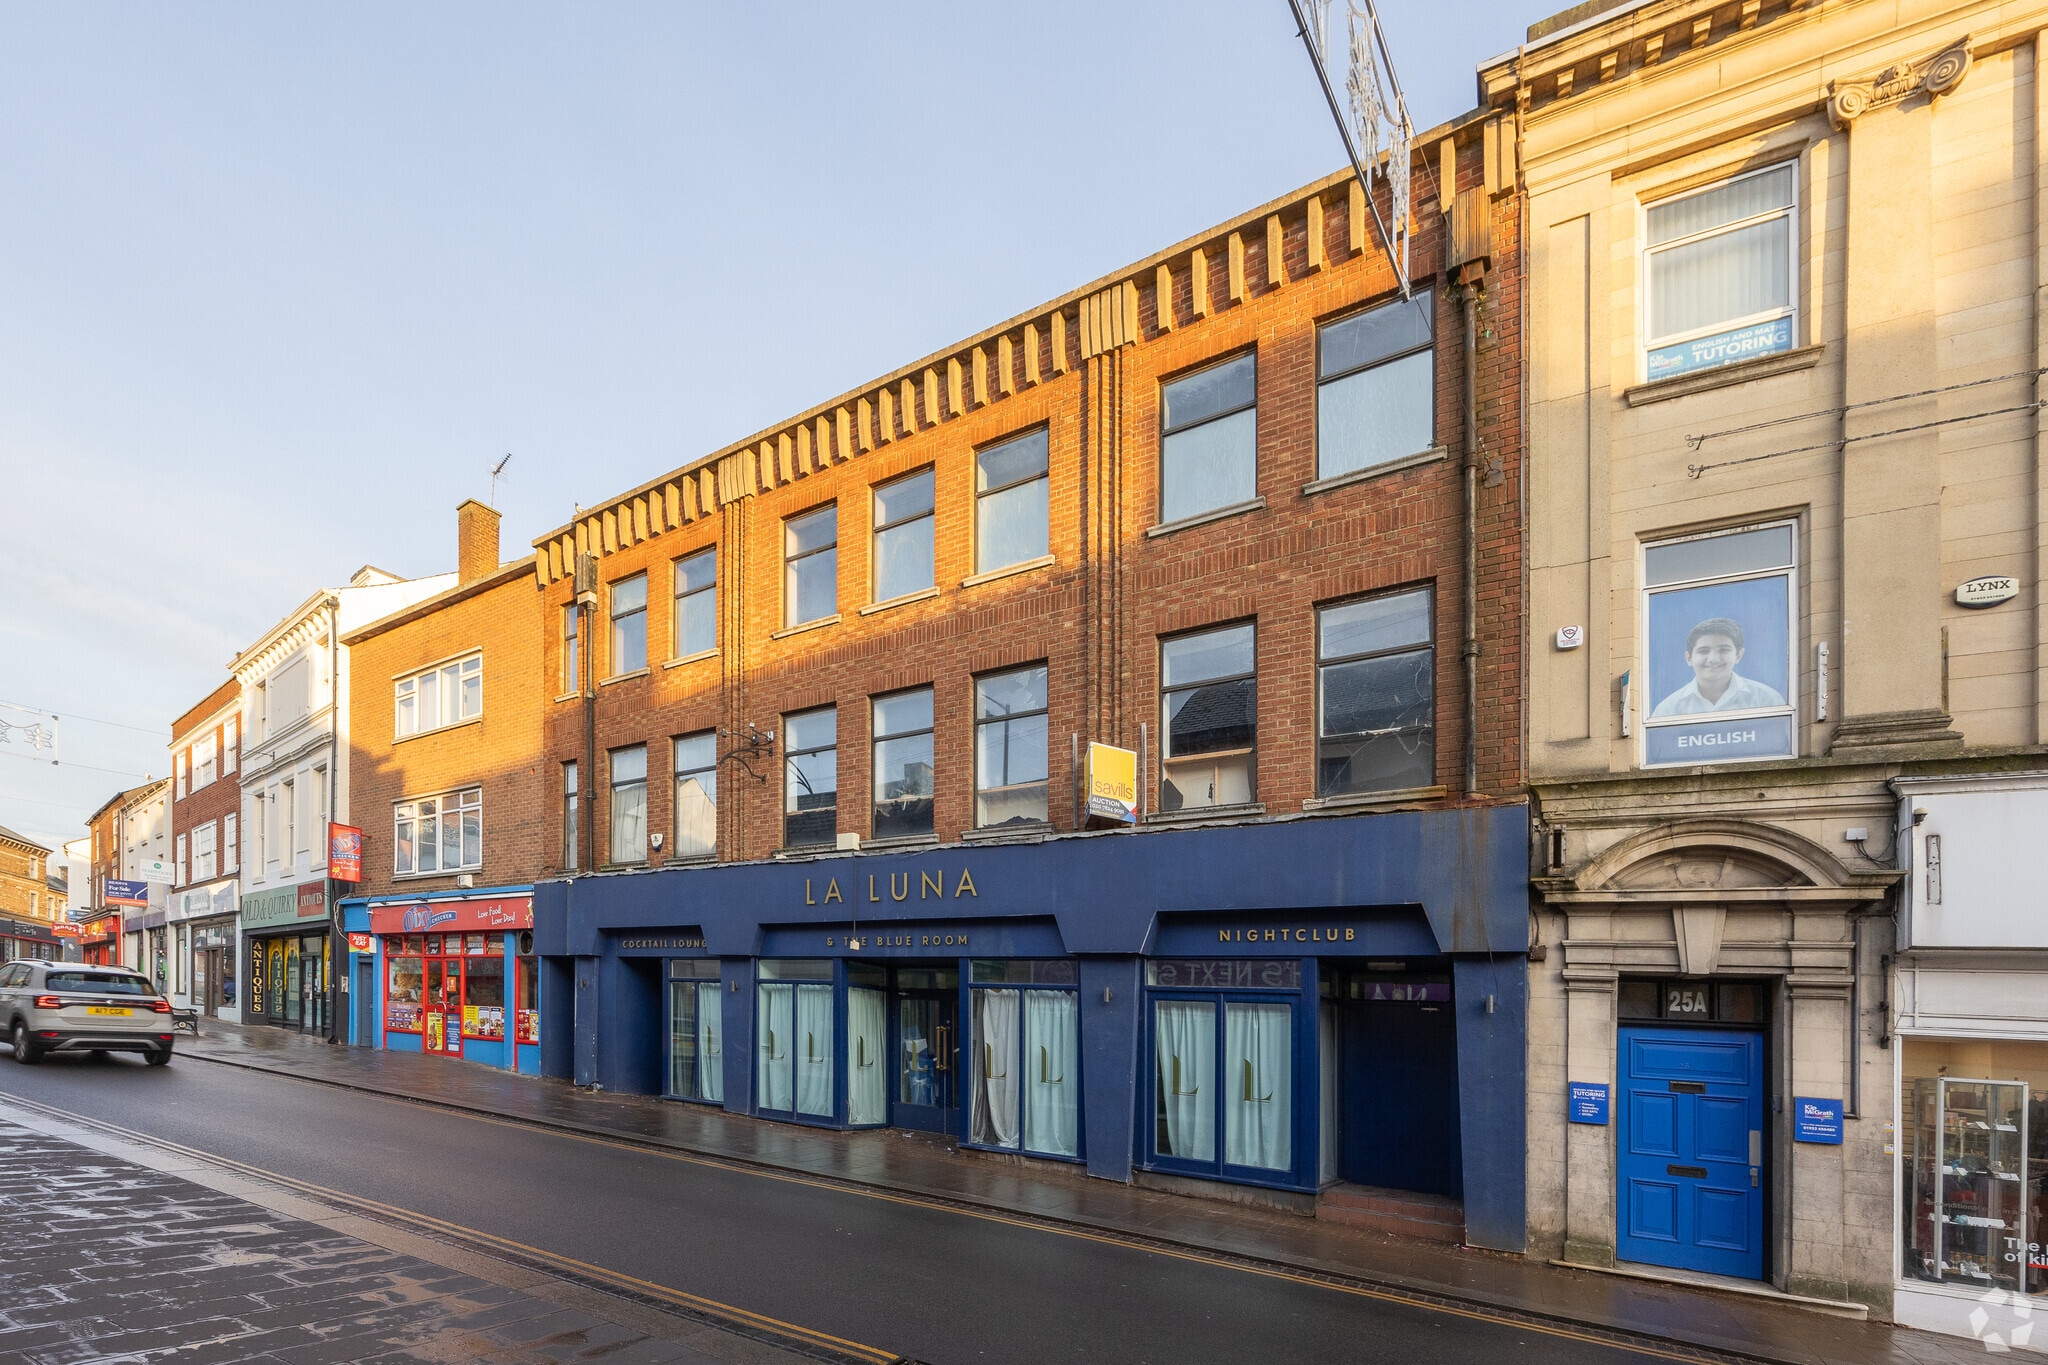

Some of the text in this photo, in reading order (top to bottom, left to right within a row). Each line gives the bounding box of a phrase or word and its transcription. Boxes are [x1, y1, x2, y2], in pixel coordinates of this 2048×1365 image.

[1692, 322, 1787, 351] ENGLISH AND MATHS
[1692, 330, 1787, 363] TUTORING
[1966, 579, 2010, 593] LYNX
[1677, 730, 1756, 748] ENGLISH
[1092, 796, 1120, 808] AUCTION
[1094, 780, 1133, 800] savills
[300, 893, 323, 907] ANTIQUES
[806, 867, 978, 905] LA LUNA
[243, 893, 297, 922] OLD & QUIRKY
[403, 905, 434, 933] Dixy
[432, 913, 453, 924] CHICKEN
[477, 909, 488, 919] Love
[491, 915, 503, 925] Love
[622, 939, 707, 949] COCKTAIL LOUNG
[826, 937, 833, 946] &
[877, 935, 912, 946] BLUE
[922, 934, 969, 946] ROOM
[1219, 928, 1355, 941] NIGHTCLUB
[252, 941, 263, 1012] ANTIQUES
[1669, 990, 1707, 1013] 25A
[707, 1025, 721, 1056] L
[769, 1029, 785, 1061] L
[808, 1031, 824, 1064] L
[859, 1035, 874, 1067] L
[911, 1039, 928, 1072] L
[985, 1042, 1007, 1080] L
[1040, 1045, 1064, 1084] L
[1172, 1053, 1200, 1097] L
[1243, 1058, 1274, 1104] L
[2003, 1236, 2040, 1252] The
[2029, 1252, 2048, 1266] ki
